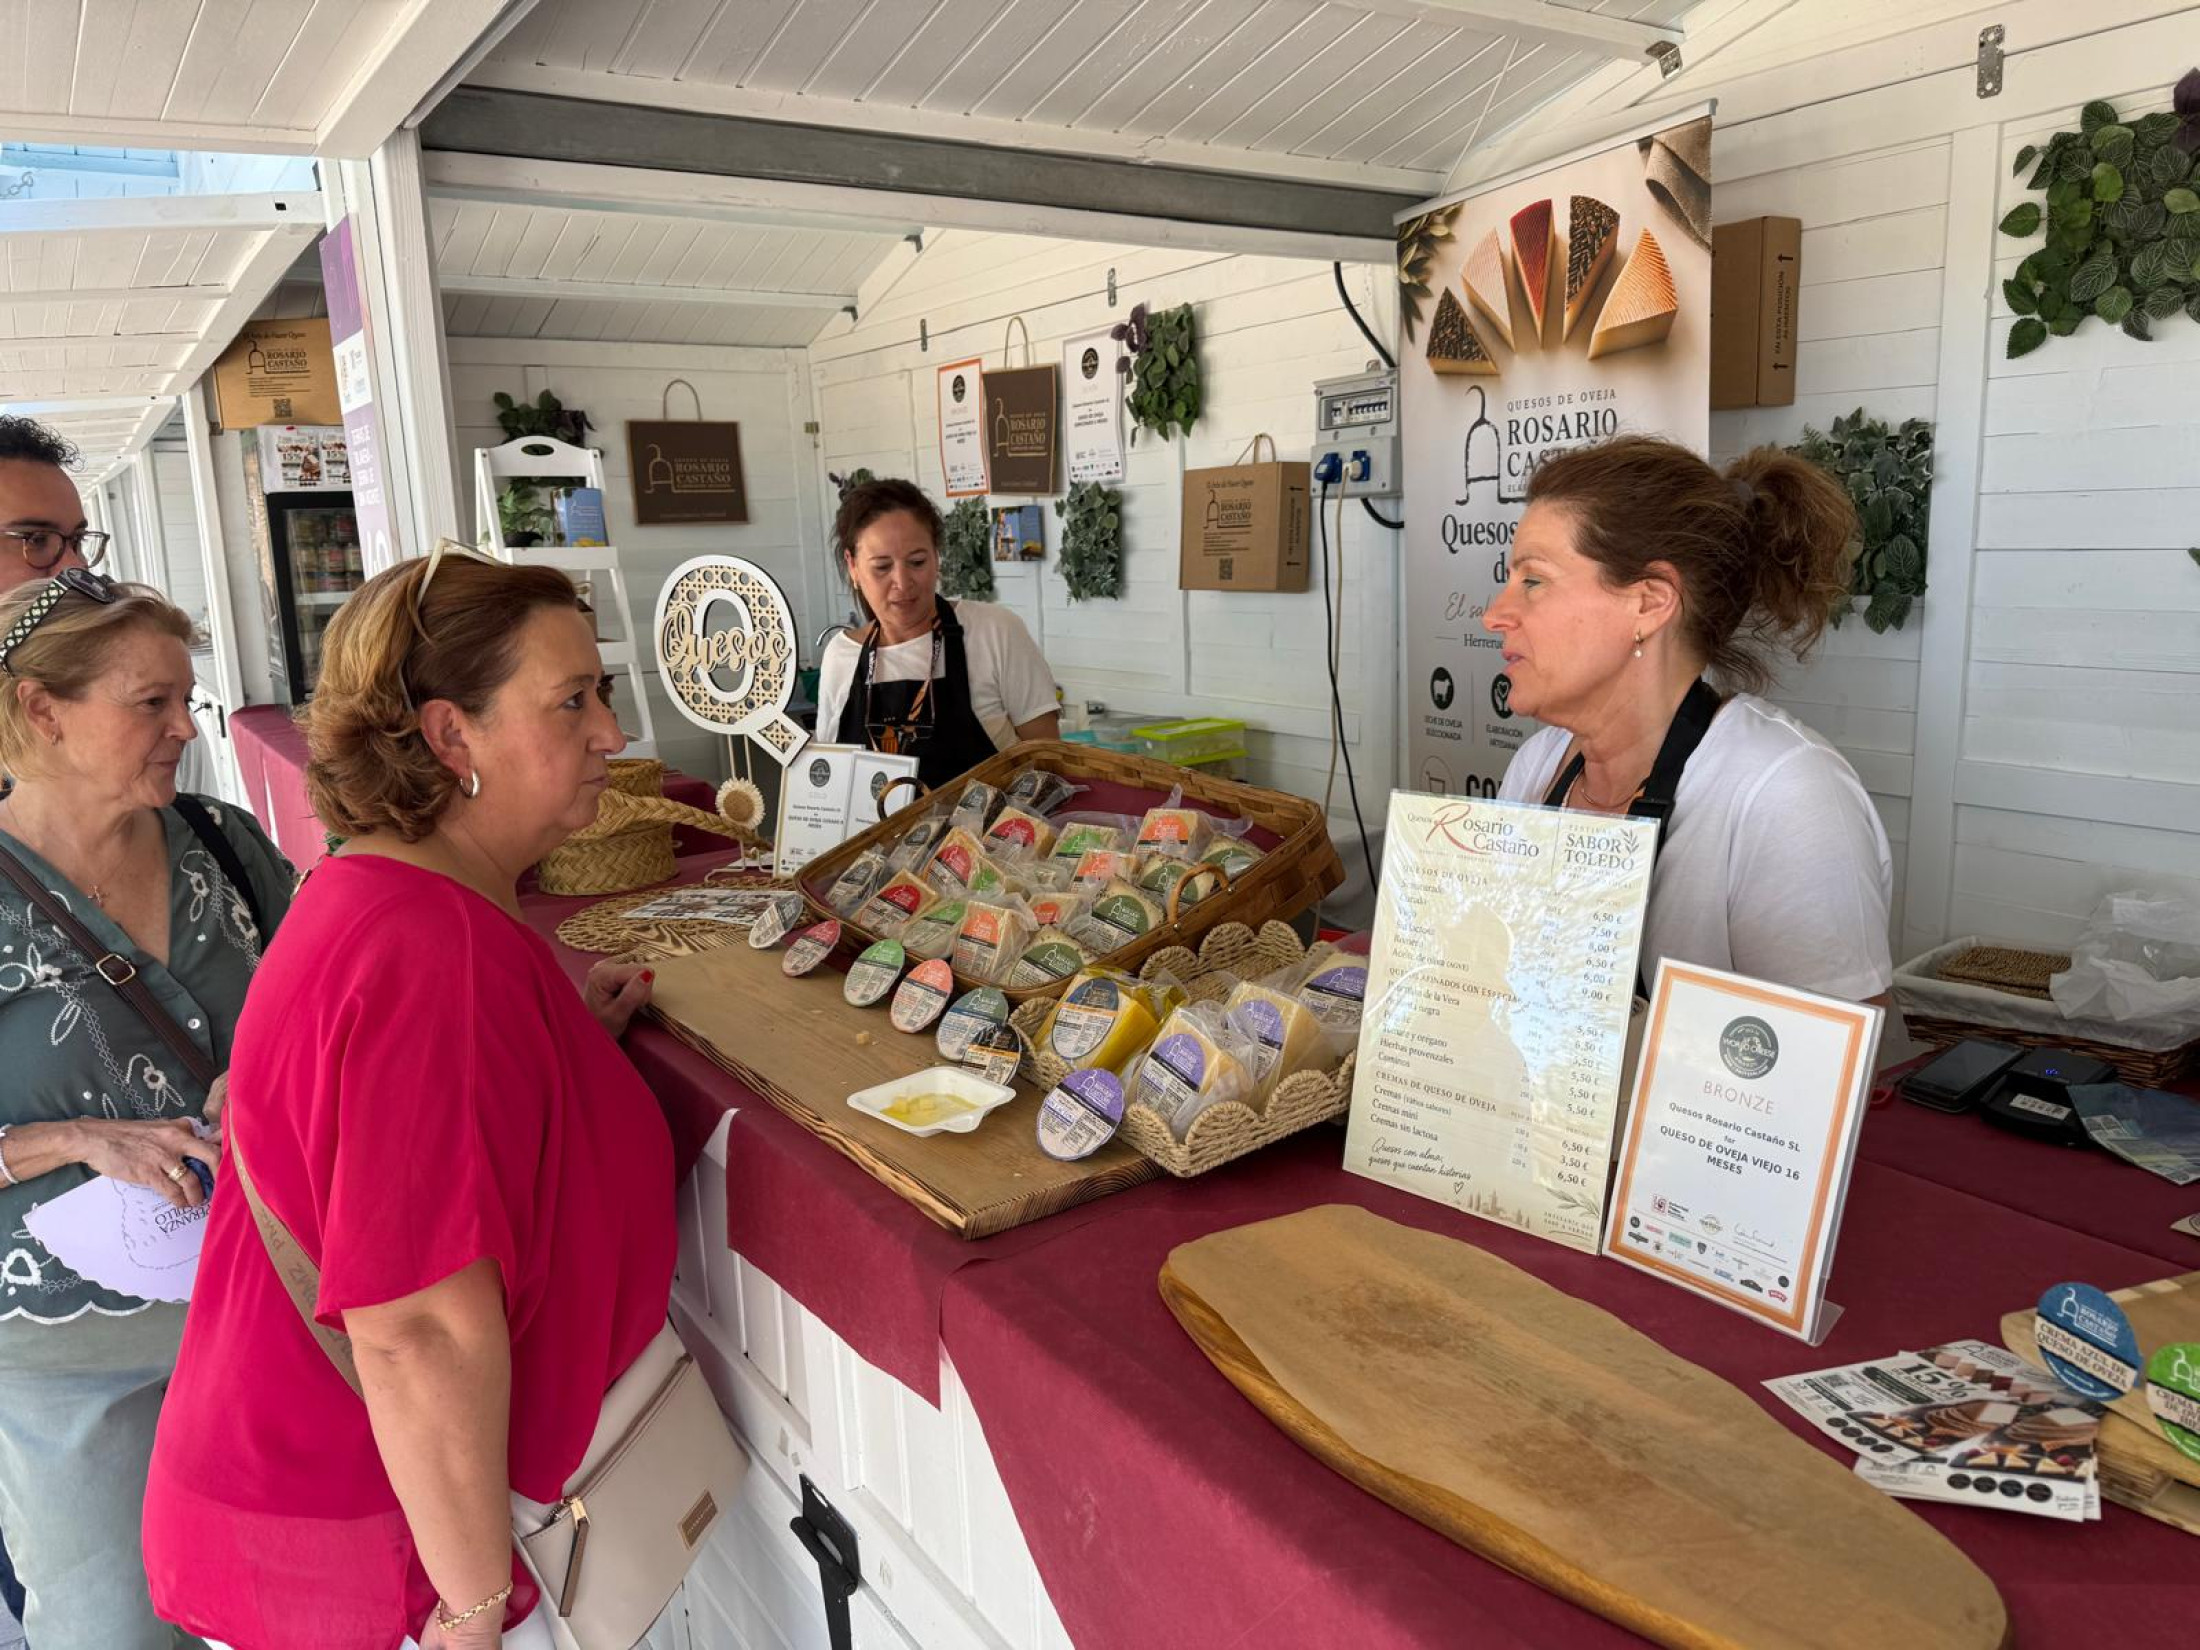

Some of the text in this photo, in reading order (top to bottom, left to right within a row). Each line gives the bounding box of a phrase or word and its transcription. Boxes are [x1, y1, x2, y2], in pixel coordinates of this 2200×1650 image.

[1507, 389, 1617, 412] QUESOS DE OVEJA
[1010, 418, 1046, 430] ROSARIO
[1507, 408, 1618, 446] ROSARIO
[674, 462, 730, 473] ROSARIO
[675, 473, 731, 484] CASTAÑO
[1445, 592, 1466, 621] El
[661, 602, 792, 675] Quesos
[1473, 832, 1540, 858] Castaño
[1565, 832, 1622, 854] SABOR
[1564, 849, 1635, 871] TOLEDO
[1592, 911, 1614, 923] 6,50
[1590, 926, 1612, 939] 7,50
[1586, 957, 1607, 969] 6,50
[1462, 983, 1478, 994] CON
[1584, 971, 1606, 984] 6,00
[1582, 987, 1603, 1000] 9,00
[1576, 1025, 1598, 1038] 5,50
[1378, 1051, 1595, 1119] Cominos 5,50 €
[1409, 1047, 1454, 1064] provenzales
[1568, 1086, 1589, 1100] 5,50
[1591, 1092, 1597, 1102] €
[1570, 1071, 1592, 1085] 5,50
[1376, 1070, 1496, 1112] CREMAS DE QUESO DE OVEJA
[1703, 1080, 1775, 1115] BRONZE
[1374, 1084, 1401, 1099] Cremas
[1561, 1139, 1584, 1153] 6,50
[1584, 1146, 1591, 1156] €
[1668, 1101, 1801, 1152] Quesos Rosario Castaño SL
[1371, 1098, 1589, 1172] Cremas mini 3,50 €
[1371, 1136, 1402, 1155] Quesos
[1403, 1148, 1417, 1158] con
[1724, 1134, 1736, 1145] for
[1370, 1113, 1587, 1188] Cremas sin lactosa 6,50 €
[1660, 1125, 1800, 1181] QUESO DE OVEJA VIEJO 16
[1368, 1156, 1472, 1181] quesos que cuentan historias
[1706, 1154, 1743, 1175] MESES
[159, 1205, 210, 1234] PERANZA
[2037, 1333, 2073, 1356] QUESO
[2075, 1351, 2090, 1368] DE
[2092, 1363, 2127, 1388] OVEJA
[2040, 1323, 2077, 1348] CREMA
[2082, 1342, 2109, 1366] AZUL
[2111, 1361, 2126, 1376] DE
